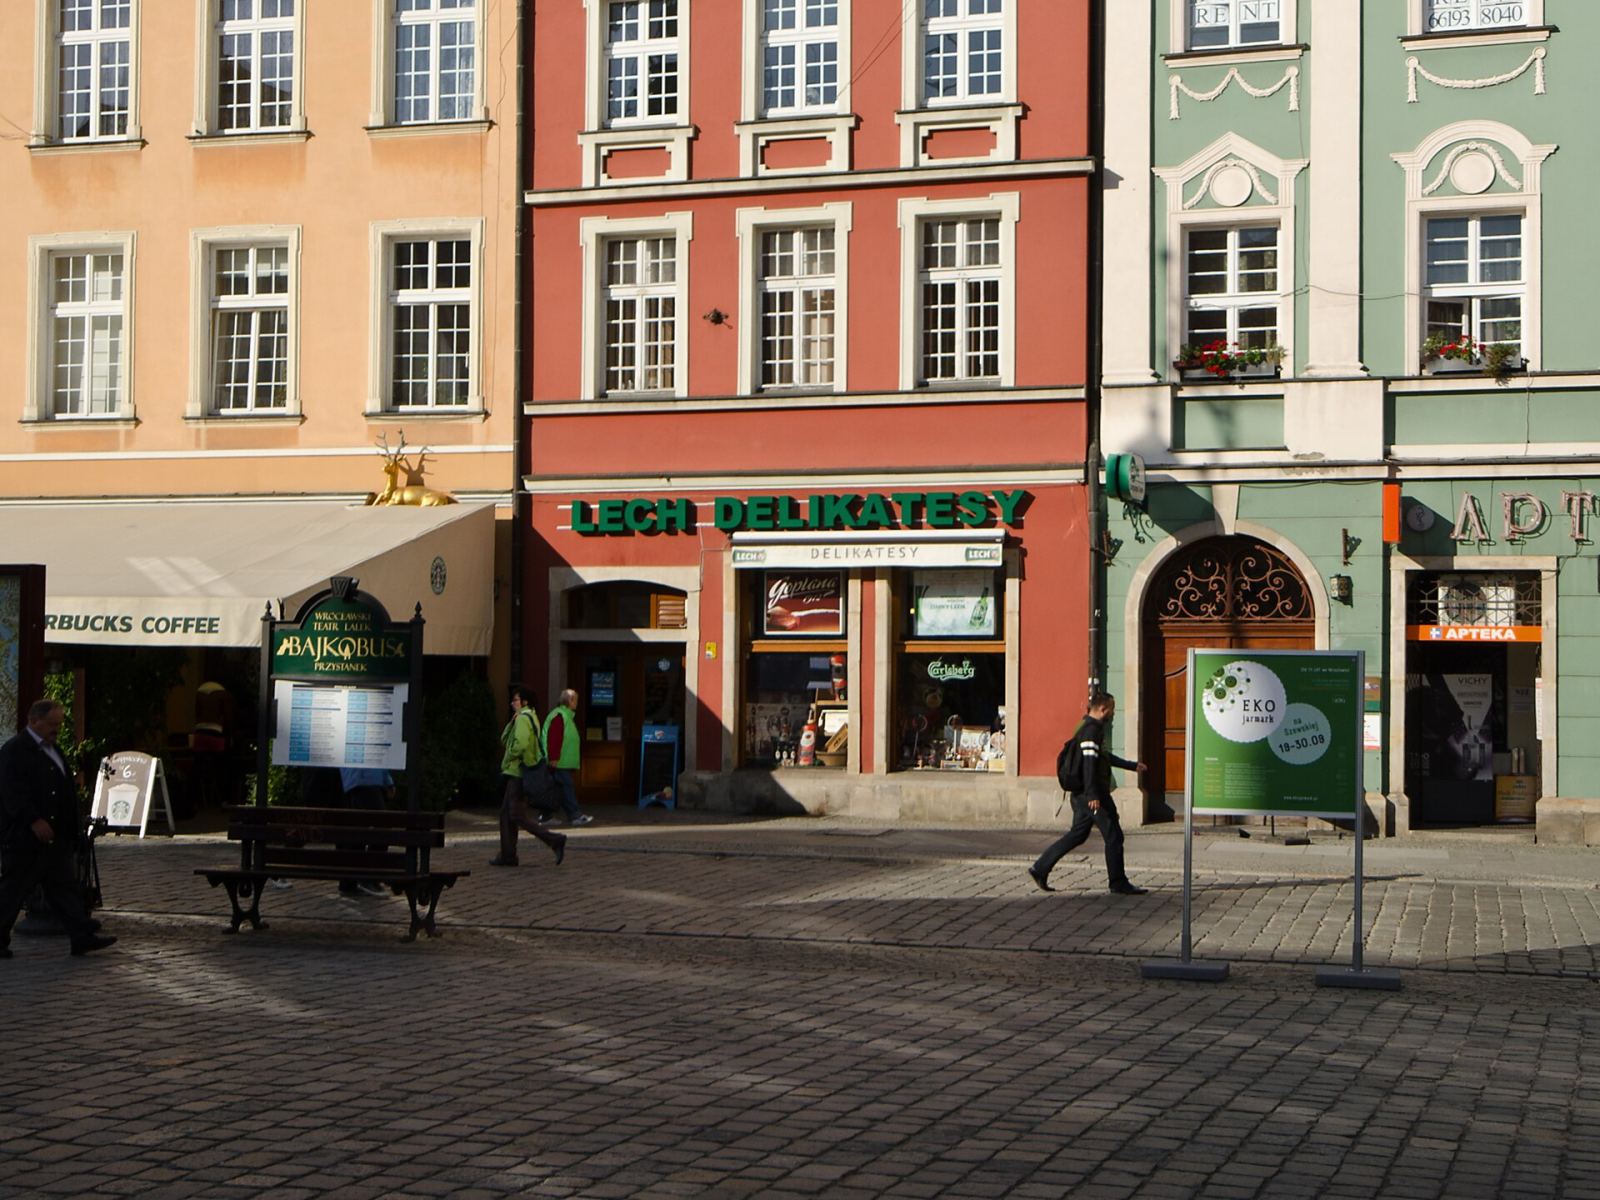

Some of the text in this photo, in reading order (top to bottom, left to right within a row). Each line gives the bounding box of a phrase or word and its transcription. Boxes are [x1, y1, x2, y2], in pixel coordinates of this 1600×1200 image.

[1197, 2, 1276, 23] RENT
[571, 490, 1026, 532] LECH DELIKATESY
[736, 552, 757, 561] LECH
[811, 547, 919, 560] DELIKATESY
[968, 550, 991, 559] LECH
[141, 616, 221, 634] COFFEE
[313, 622, 340, 631] TEATR
[1445, 628, 1517, 640] APTEKA
[314, 662, 368, 672] PRZYSTANEK
[927, 656, 976, 681] Carlsberg
[1457, 677, 1489, 685] VICHY
[1243, 699, 1276, 713] EKO
[1242, 714, 1275, 725] jarmark
